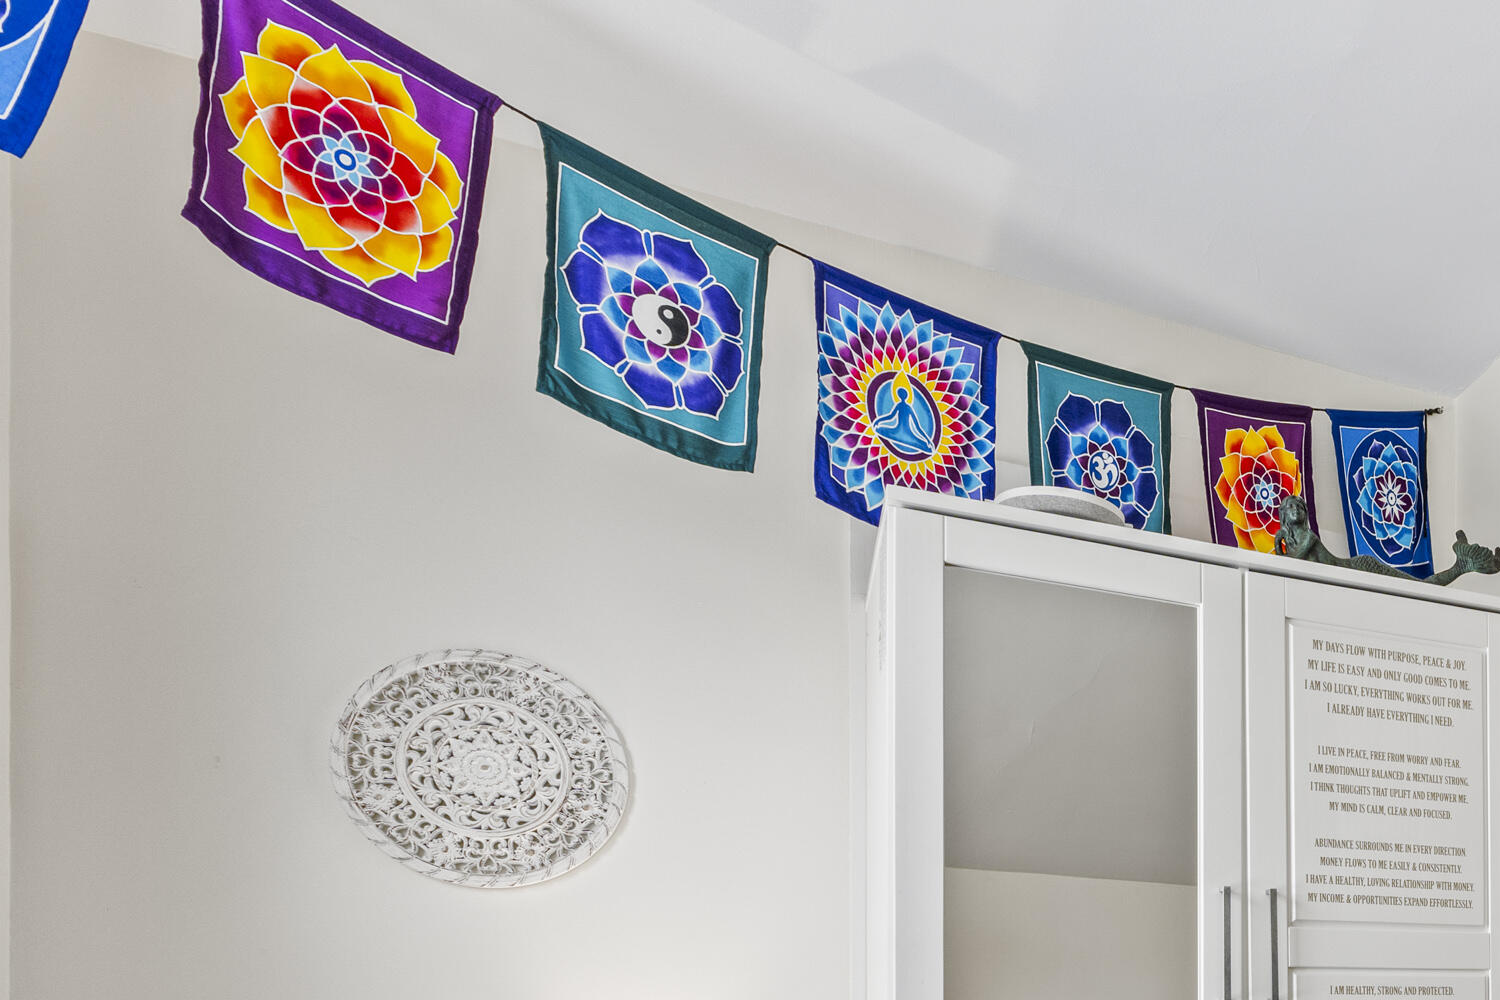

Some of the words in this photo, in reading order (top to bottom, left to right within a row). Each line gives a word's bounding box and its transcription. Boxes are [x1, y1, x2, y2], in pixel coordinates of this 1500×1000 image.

[1313, 640, 1323, 651] MY
[1326, 642, 1344, 654] DAYS
[1346, 644, 1365, 657] FLOW
[1368, 646, 1386, 660] WITH
[1423, 654, 1444, 668] PEACE
[1310, 680, 1320, 691] AM
[1323, 682, 1332, 693] SO
[1361, 686, 1404, 702] EVERYTHING
[1406, 692, 1430, 705] WORKS
[1432, 696, 1445, 707] OUT
[1448, 698, 1461, 709] FOR
[1332, 704, 1364, 717] ALREADY
[1367, 708, 1385, 719] HAVE
[1387, 710, 1429, 724] EVERYTHING
[1313, 764, 1323, 774] AM
[1325, 764, 1369, 778] EMOTIONALLY
[1372, 768, 1404, 781] BALANCED
[1413, 772, 1443, 784] MENTALLY
[1315, 782, 1334, 793] THINK
[1336, 784, 1370, 796] THOUGHTS
[1372, 786, 1387, 797] THAT
[1390, 788, 1410, 799] UPLIFT
[1413, 790, 1425, 800] AND
[1427, 792, 1457, 803] EMPOWER
[1315, 838, 1353, 850] ABUNDANCE
[1356, 840, 1393, 852] SURROUNDS
[1395, 844, 1404, 853] ME
[1405, 844, 1411, 853] IN
[1413, 844, 1432, 855] EVERY
[1320, 856, 1343, 867] MONEY
[1345, 858, 1366, 868] FLOWS
[1368, 860, 1377, 869] TO
[1378, 860, 1387, 869] ME
[1389, 860, 1410, 871] EASILY
[1310, 874, 1327, 885] HAVE
[1367, 878, 1390, 888] LOVING
[1392, 878, 1434, 890] RELATIONSHIP
[1436, 880, 1452, 891] WITH
[1308, 892, 1317, 903] MY
[1320, 894, 1344, 904] INCOME
[1353, 894, 1402, 906] OPPORTUNITIES
[1404, 898, 1428, 907] EXPAND
[1334, 986, 1344, 995] AM
[1378, 986, 1402, 995] STRONG
[1404, 986, 1417, 996] AND
